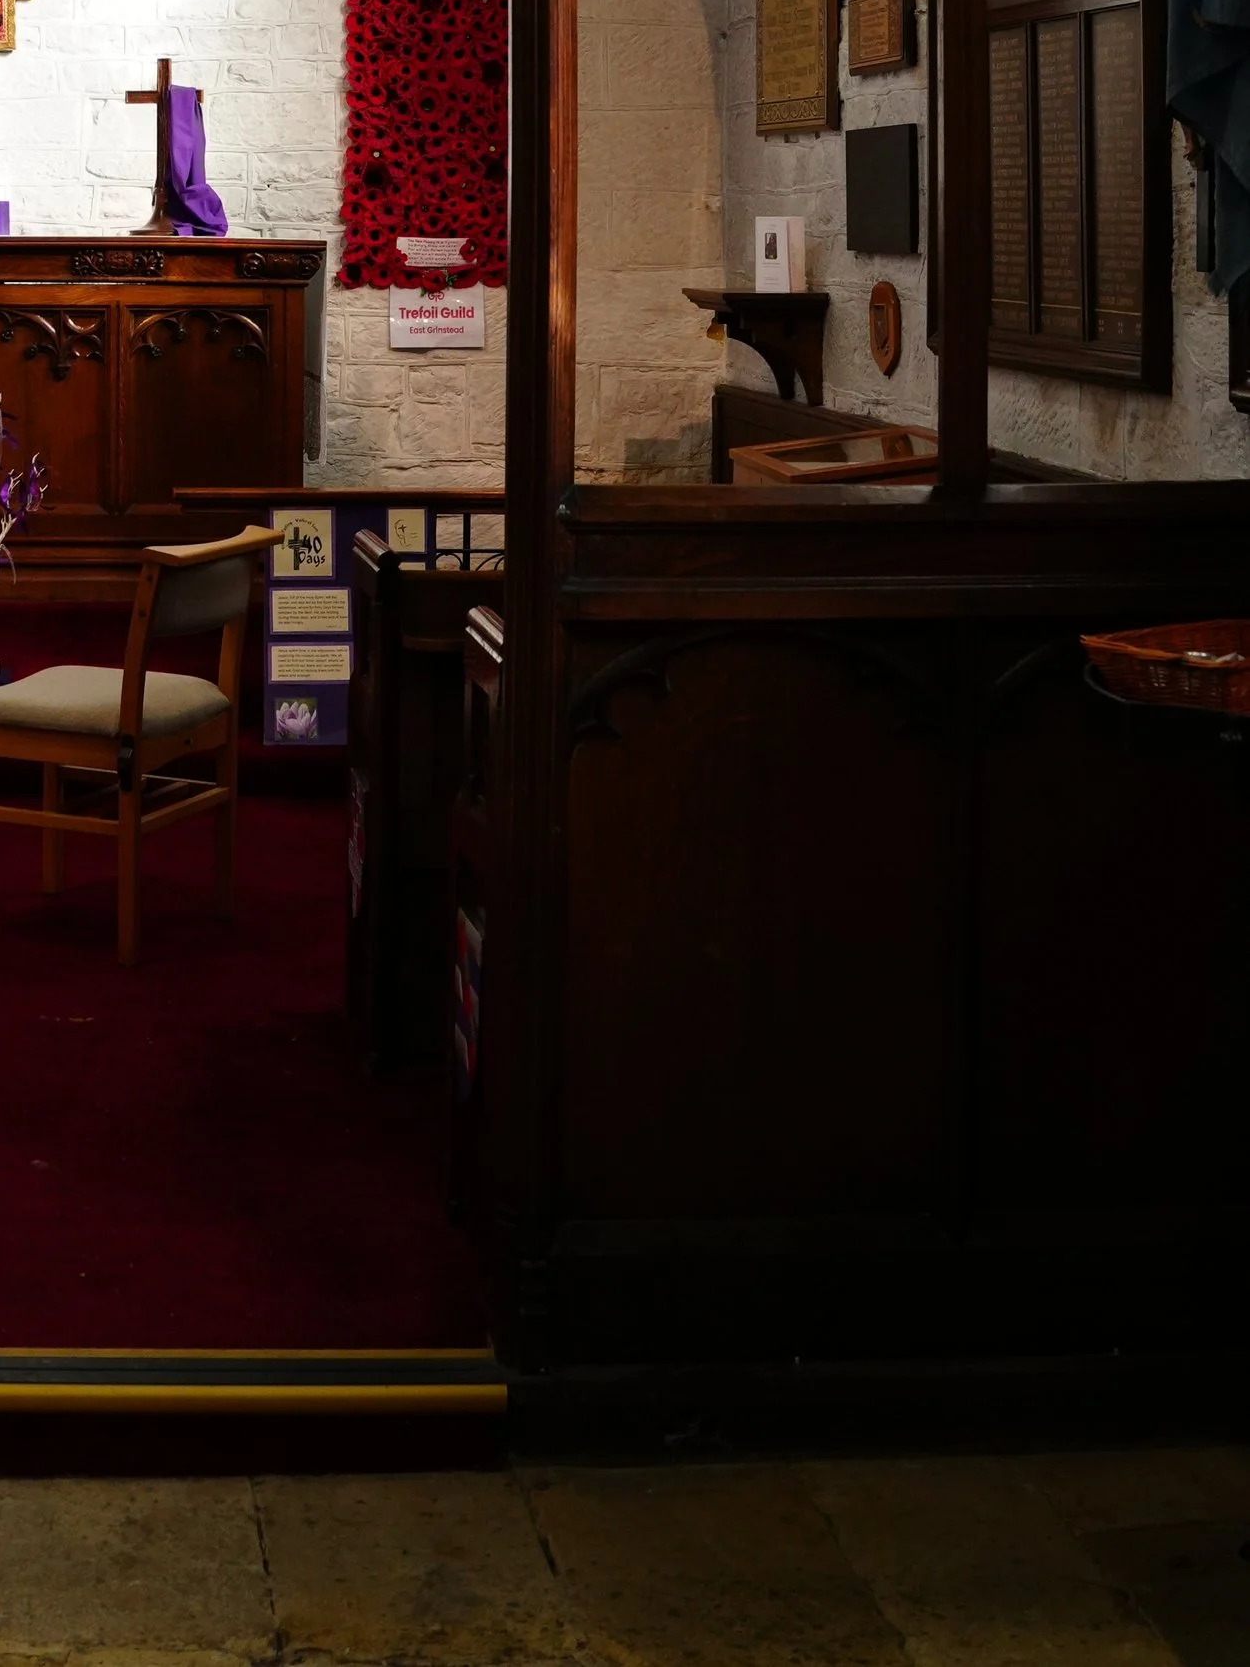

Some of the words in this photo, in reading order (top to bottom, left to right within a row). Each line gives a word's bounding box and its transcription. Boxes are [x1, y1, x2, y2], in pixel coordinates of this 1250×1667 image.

[398, 306, 438, 319] Trefoil
[440, 306, 475, 319] Guild
[409, 326, 426, 334] East
[427, 326, 464, 334] Grinstead
[301, 534, 323, 554] 40
[298, 550, 326, 567] Days
